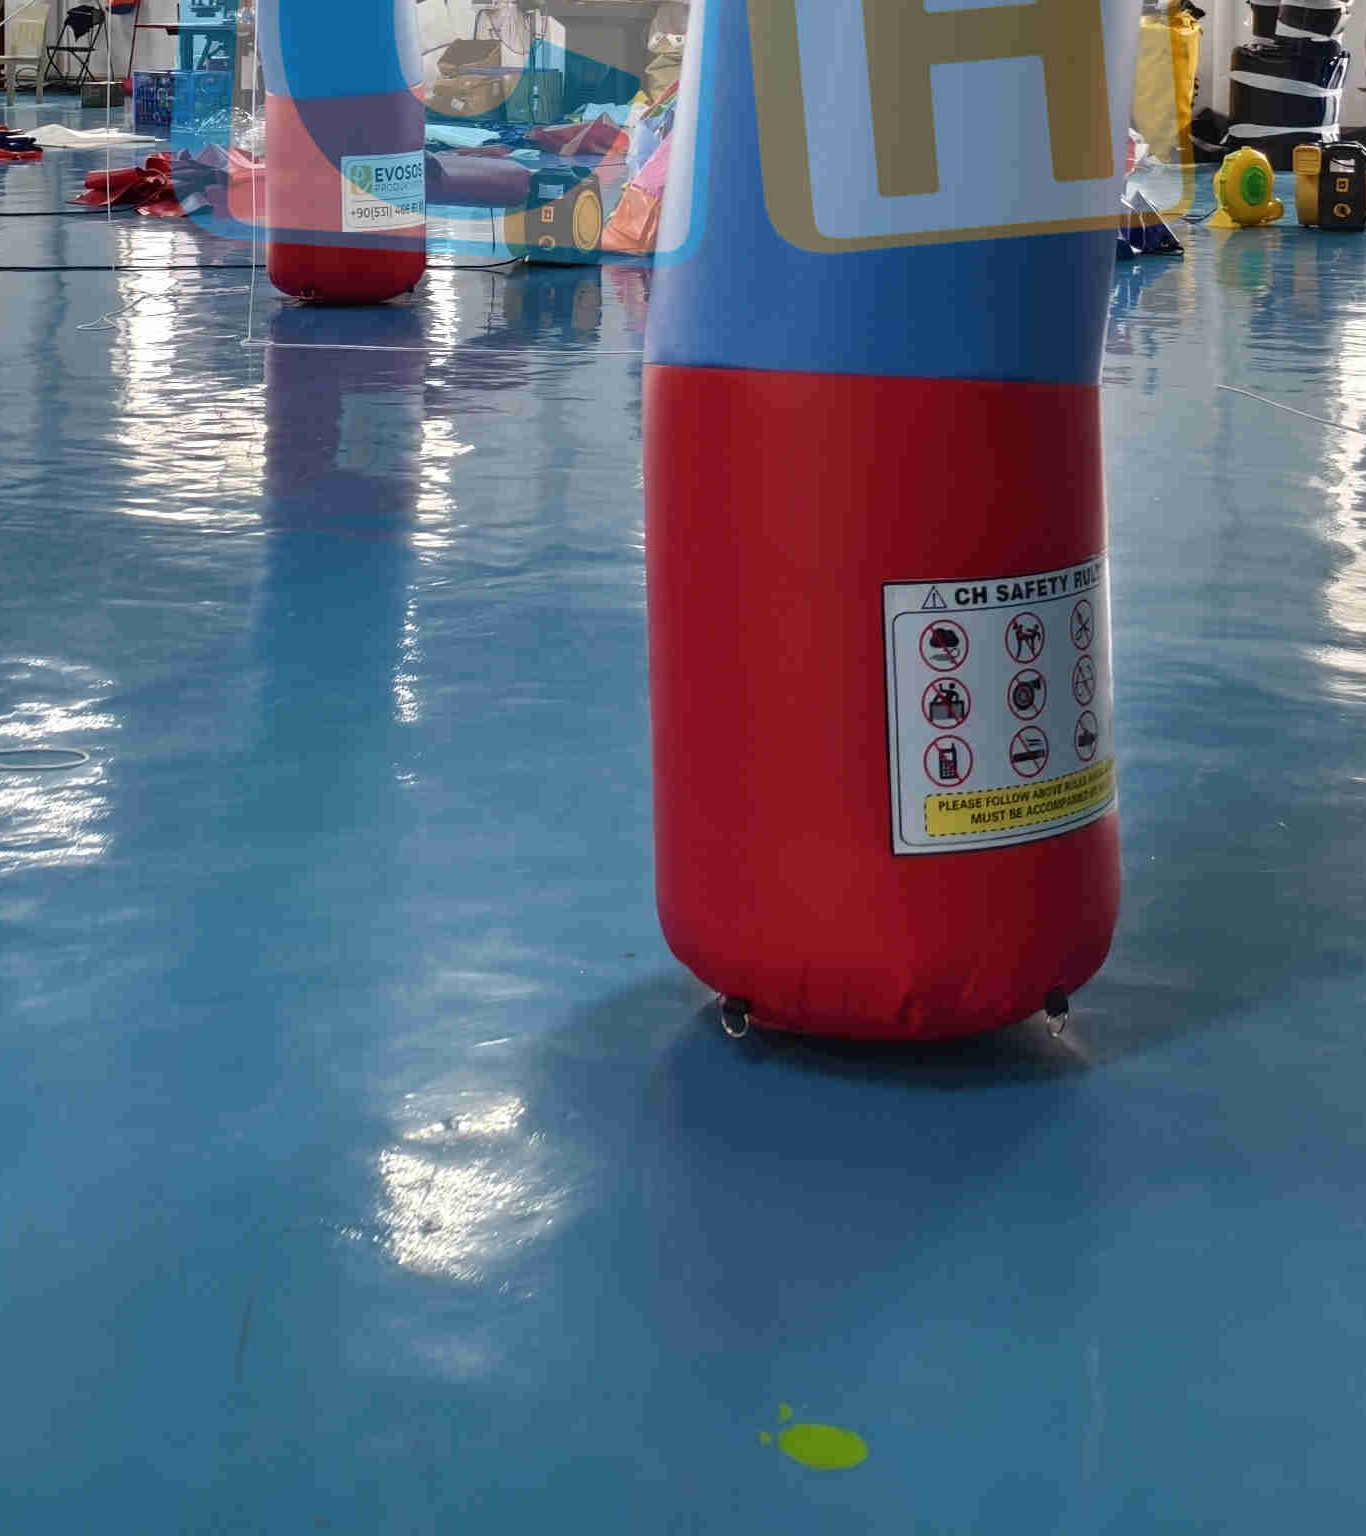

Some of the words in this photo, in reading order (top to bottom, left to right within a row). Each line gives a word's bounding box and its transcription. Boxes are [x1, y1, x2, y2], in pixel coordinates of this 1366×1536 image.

[954, 586, 987, 606] CH
[996, 575, 1068, 602] SAFETY
[938, 797, 982, 812] PLEASE
[985, 790, 1029, 809] FOLLOW
[970, 810, 1006, 824] MUST
[1009, 808, 1022, 818] BE
